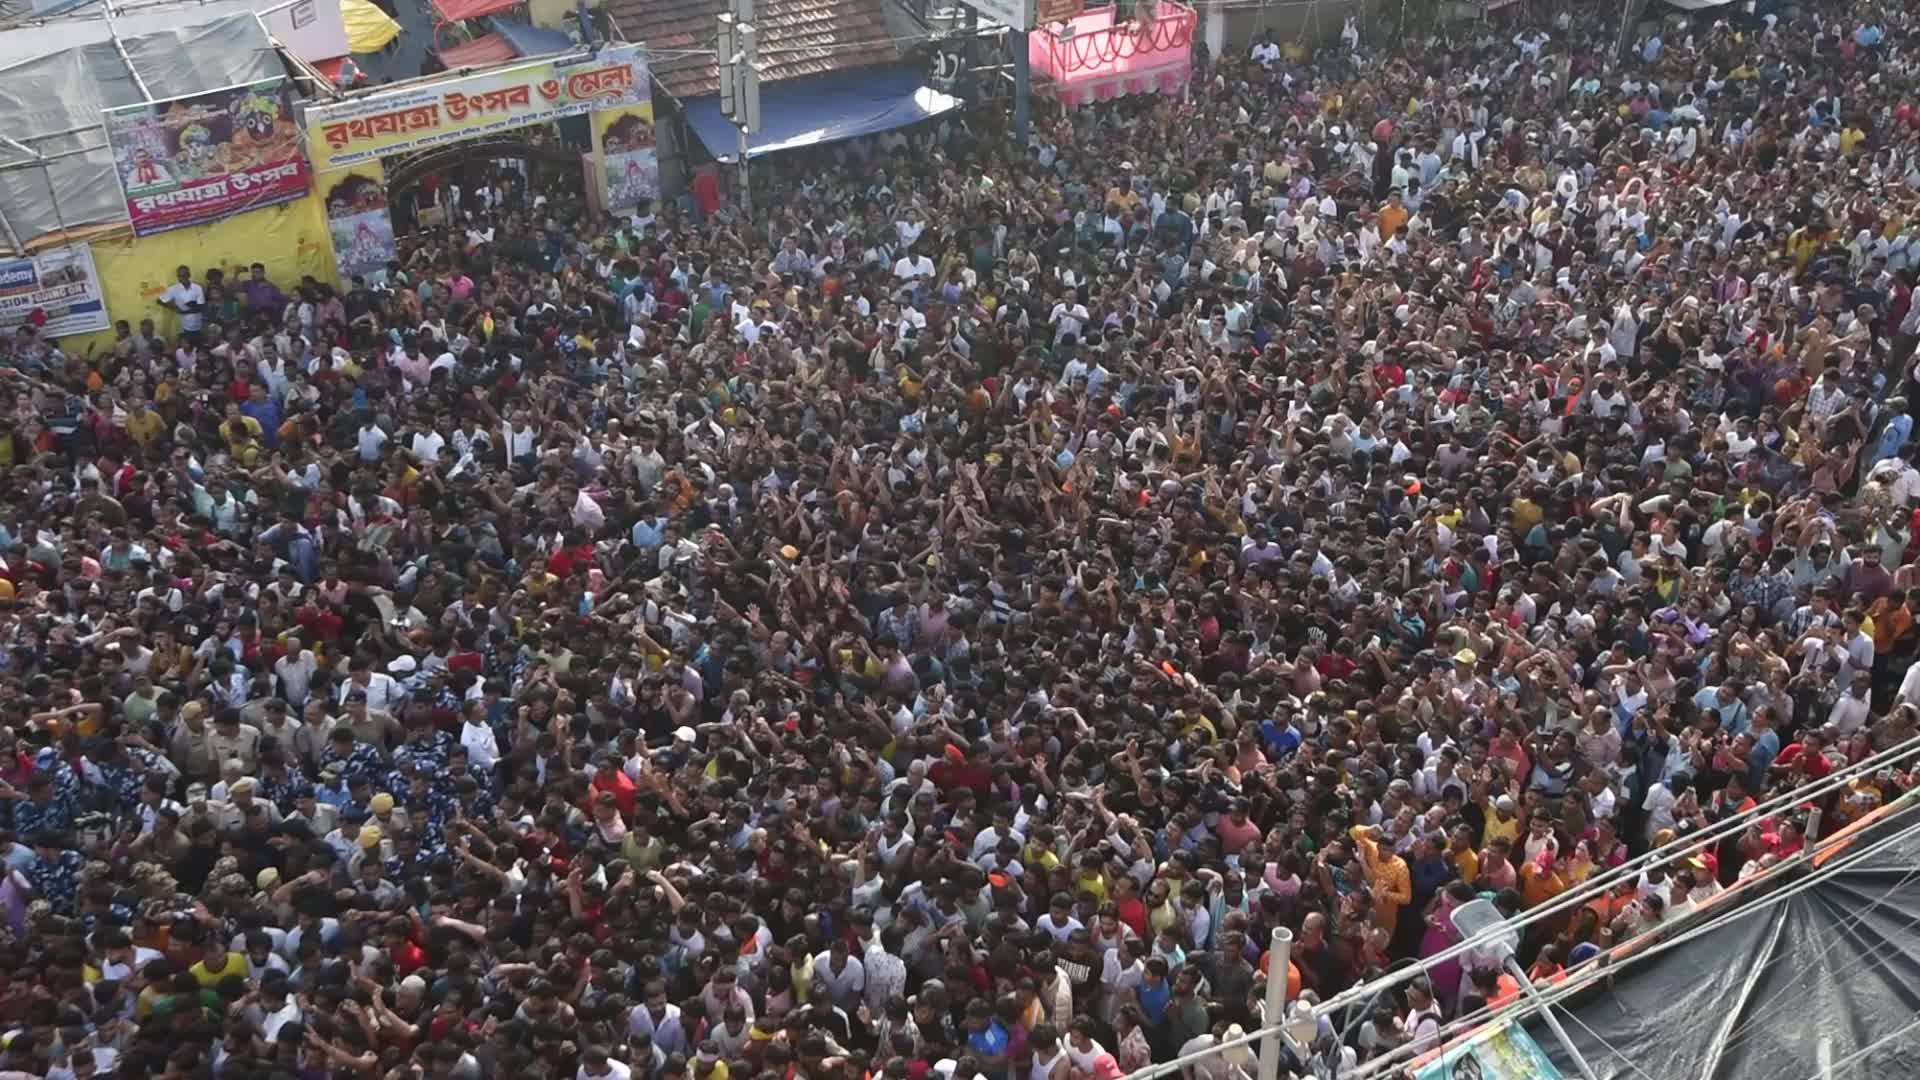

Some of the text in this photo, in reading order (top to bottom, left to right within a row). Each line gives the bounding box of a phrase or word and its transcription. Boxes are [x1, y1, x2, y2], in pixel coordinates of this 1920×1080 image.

[321, 103, 438, 149] রথযাত্রা
[443, 84, 530, 121] উৎসব
[537, 79, 561, 101] ও
[568, 64, 633, 99] মেলা
[134, 181, 228, 212] রথযাত্রা
[230, 163, 298, 190] উৎসব
